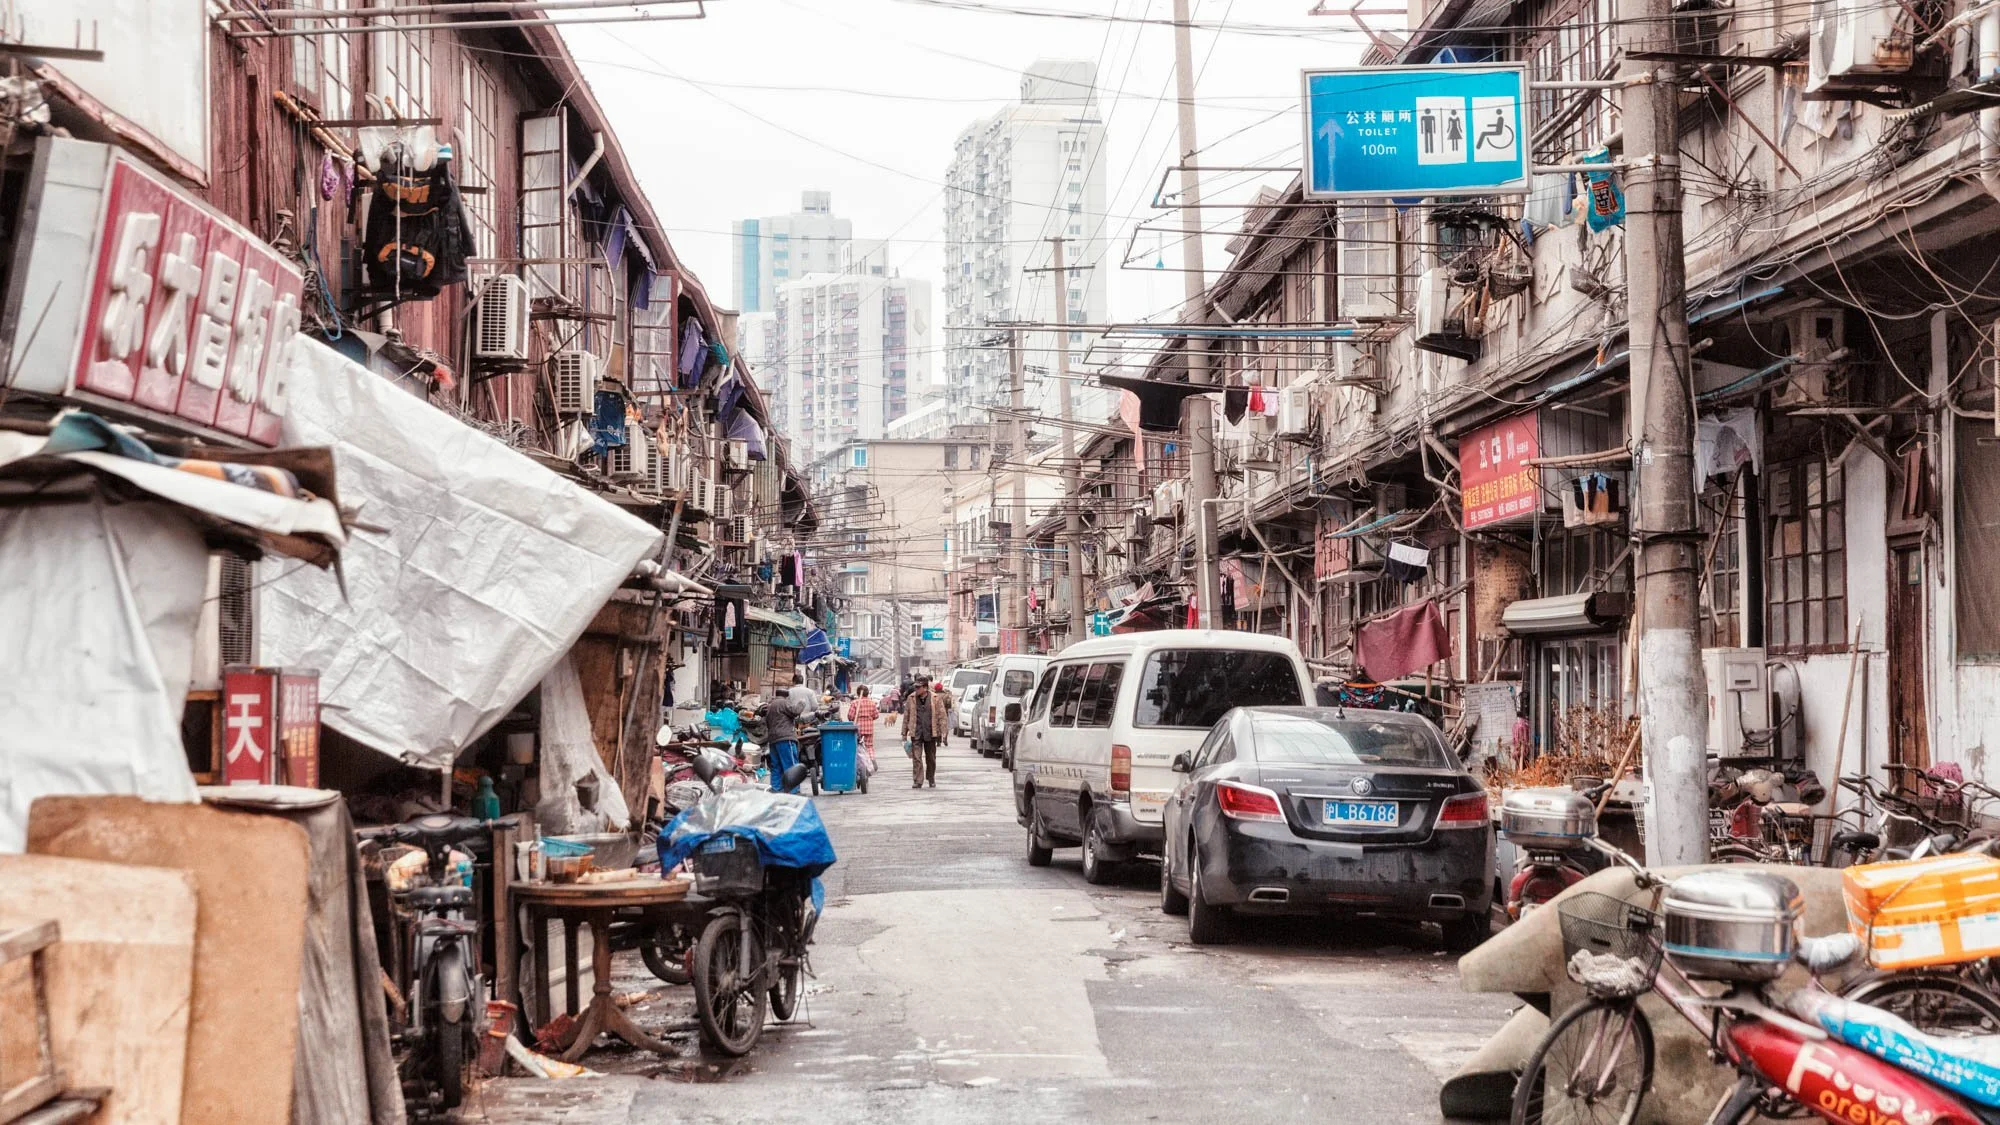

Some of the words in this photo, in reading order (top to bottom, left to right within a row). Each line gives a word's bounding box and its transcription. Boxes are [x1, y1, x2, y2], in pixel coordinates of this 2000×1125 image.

[1346, 109, 1412, 124] 公共厕所
[1357, 127, 1398, 137] TOILET
[1361, 143, 1397, 156] 100m
[227, 694, 264, 785] 天
